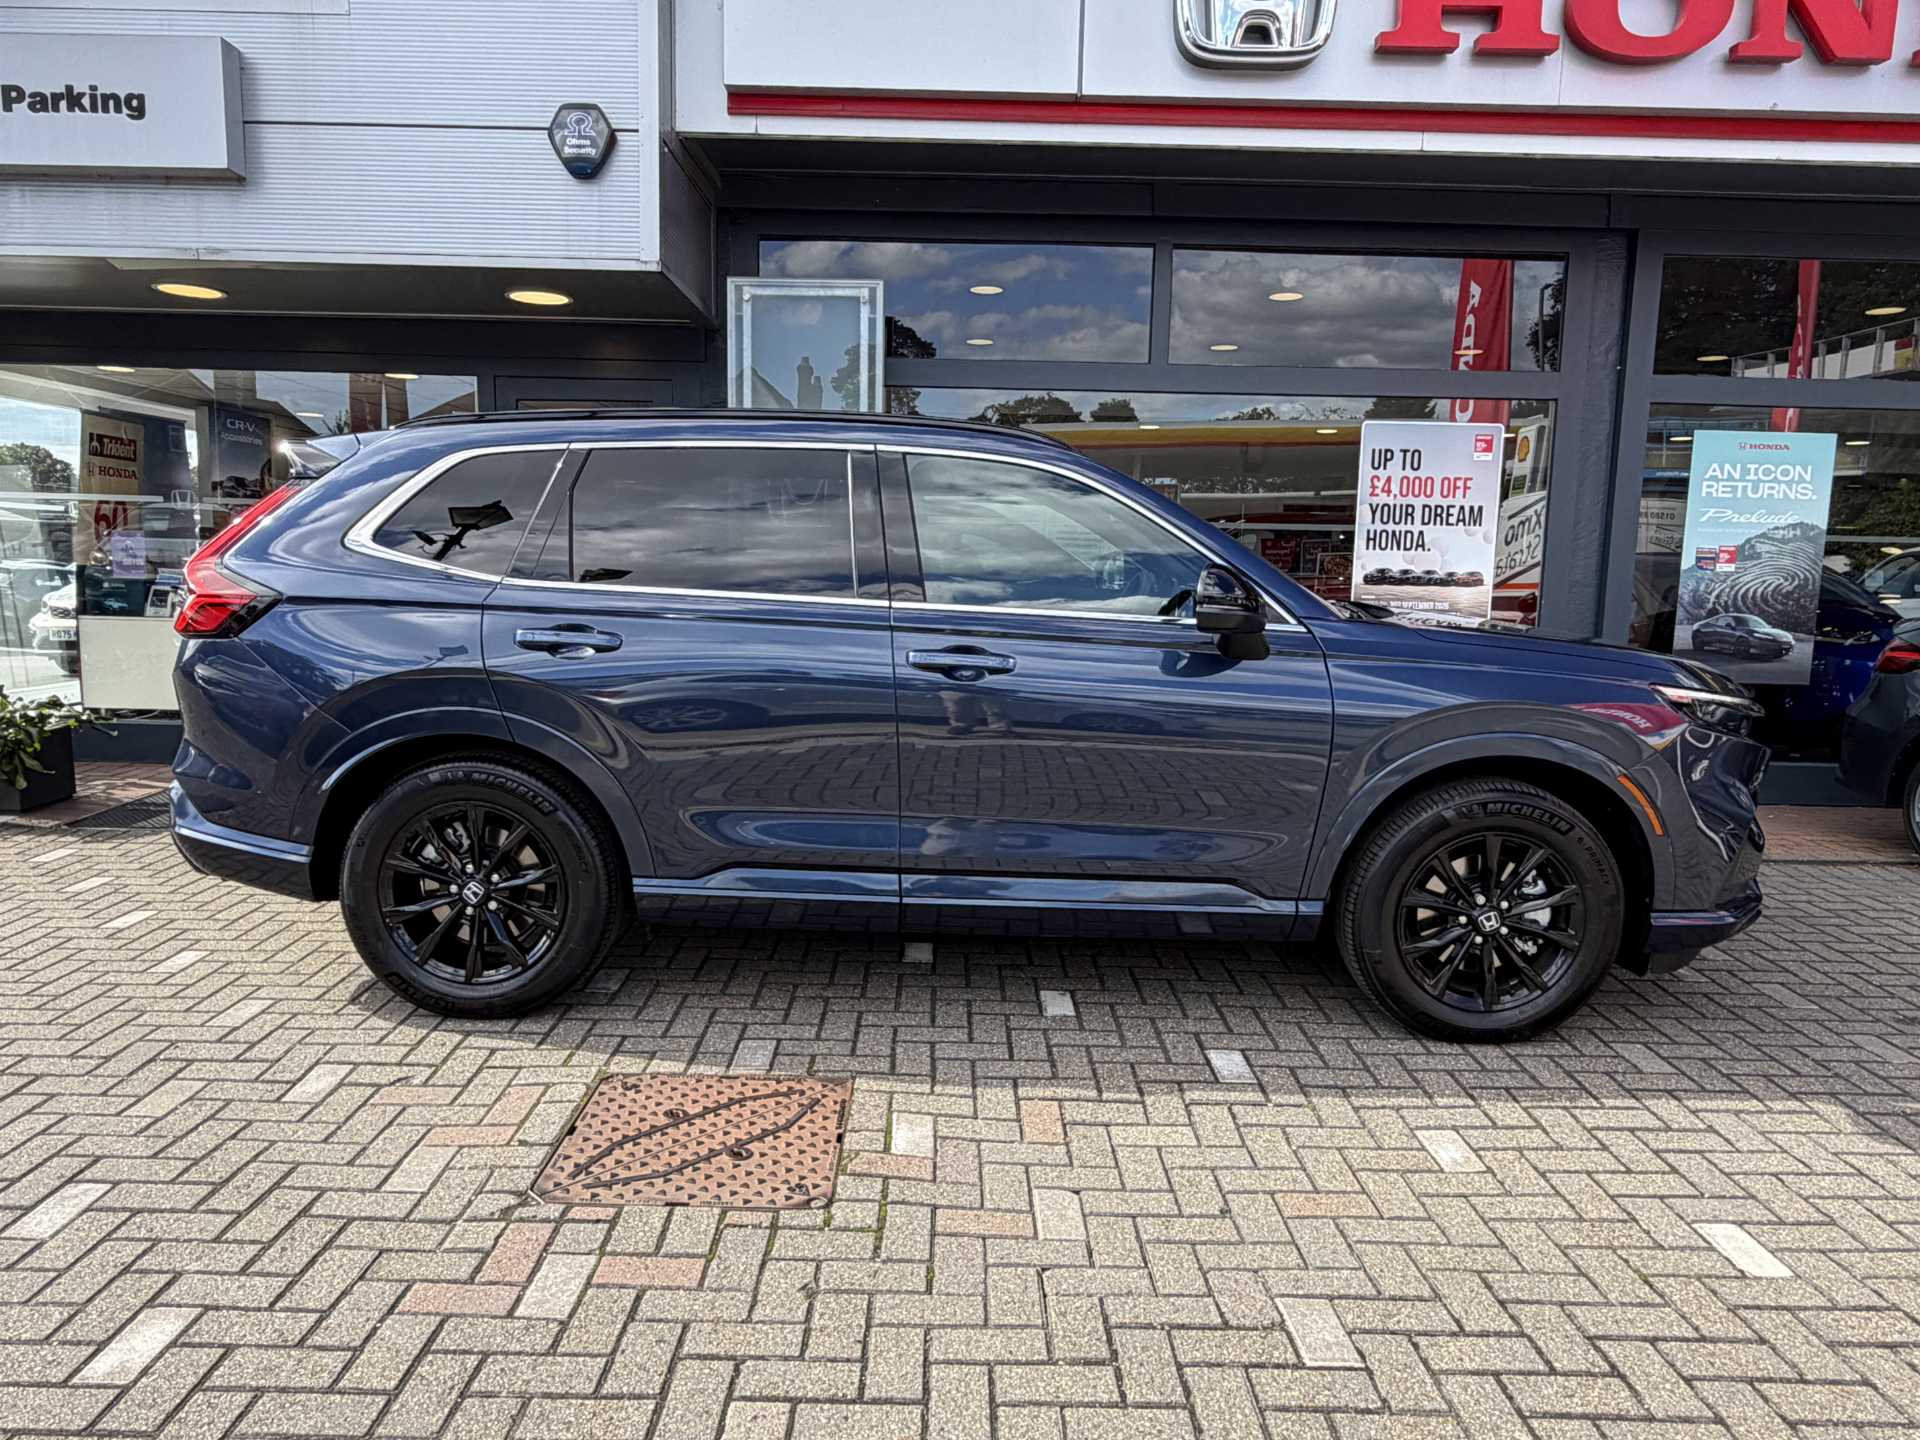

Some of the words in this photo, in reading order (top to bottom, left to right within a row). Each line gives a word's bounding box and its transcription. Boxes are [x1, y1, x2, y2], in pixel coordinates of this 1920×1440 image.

[0, 84, 146, 121] Parking
[564, 146, 596, 156] Security
[566, 137, 591, 146] Ohms
[103, 438, 136, 459] Trident
[1749, 443, 1791, 451] HONDA
[1371, 448, 1395, 471] UP
[1399, 449, 1422, 471] TO
[98, 466, 137, 480] HONDA
[1704, 463, 1741, 480] AN
[1745, 464, 1813, 482] ICON
[1369, 475, 1435, 500] £4,000
[1440, 477, 1473, 499] OFF
[1701, 481, 1818, 500] RETURNS.
[1368, 503, 1416, 526] YOUR
[1421, 504, 1483, 527] DREAM
[1699, 508, 1801, 524] Prelude
[1365, 529, 1431, 552] HONDA.
[1486, 802, 1574, 834] MICHELIN
